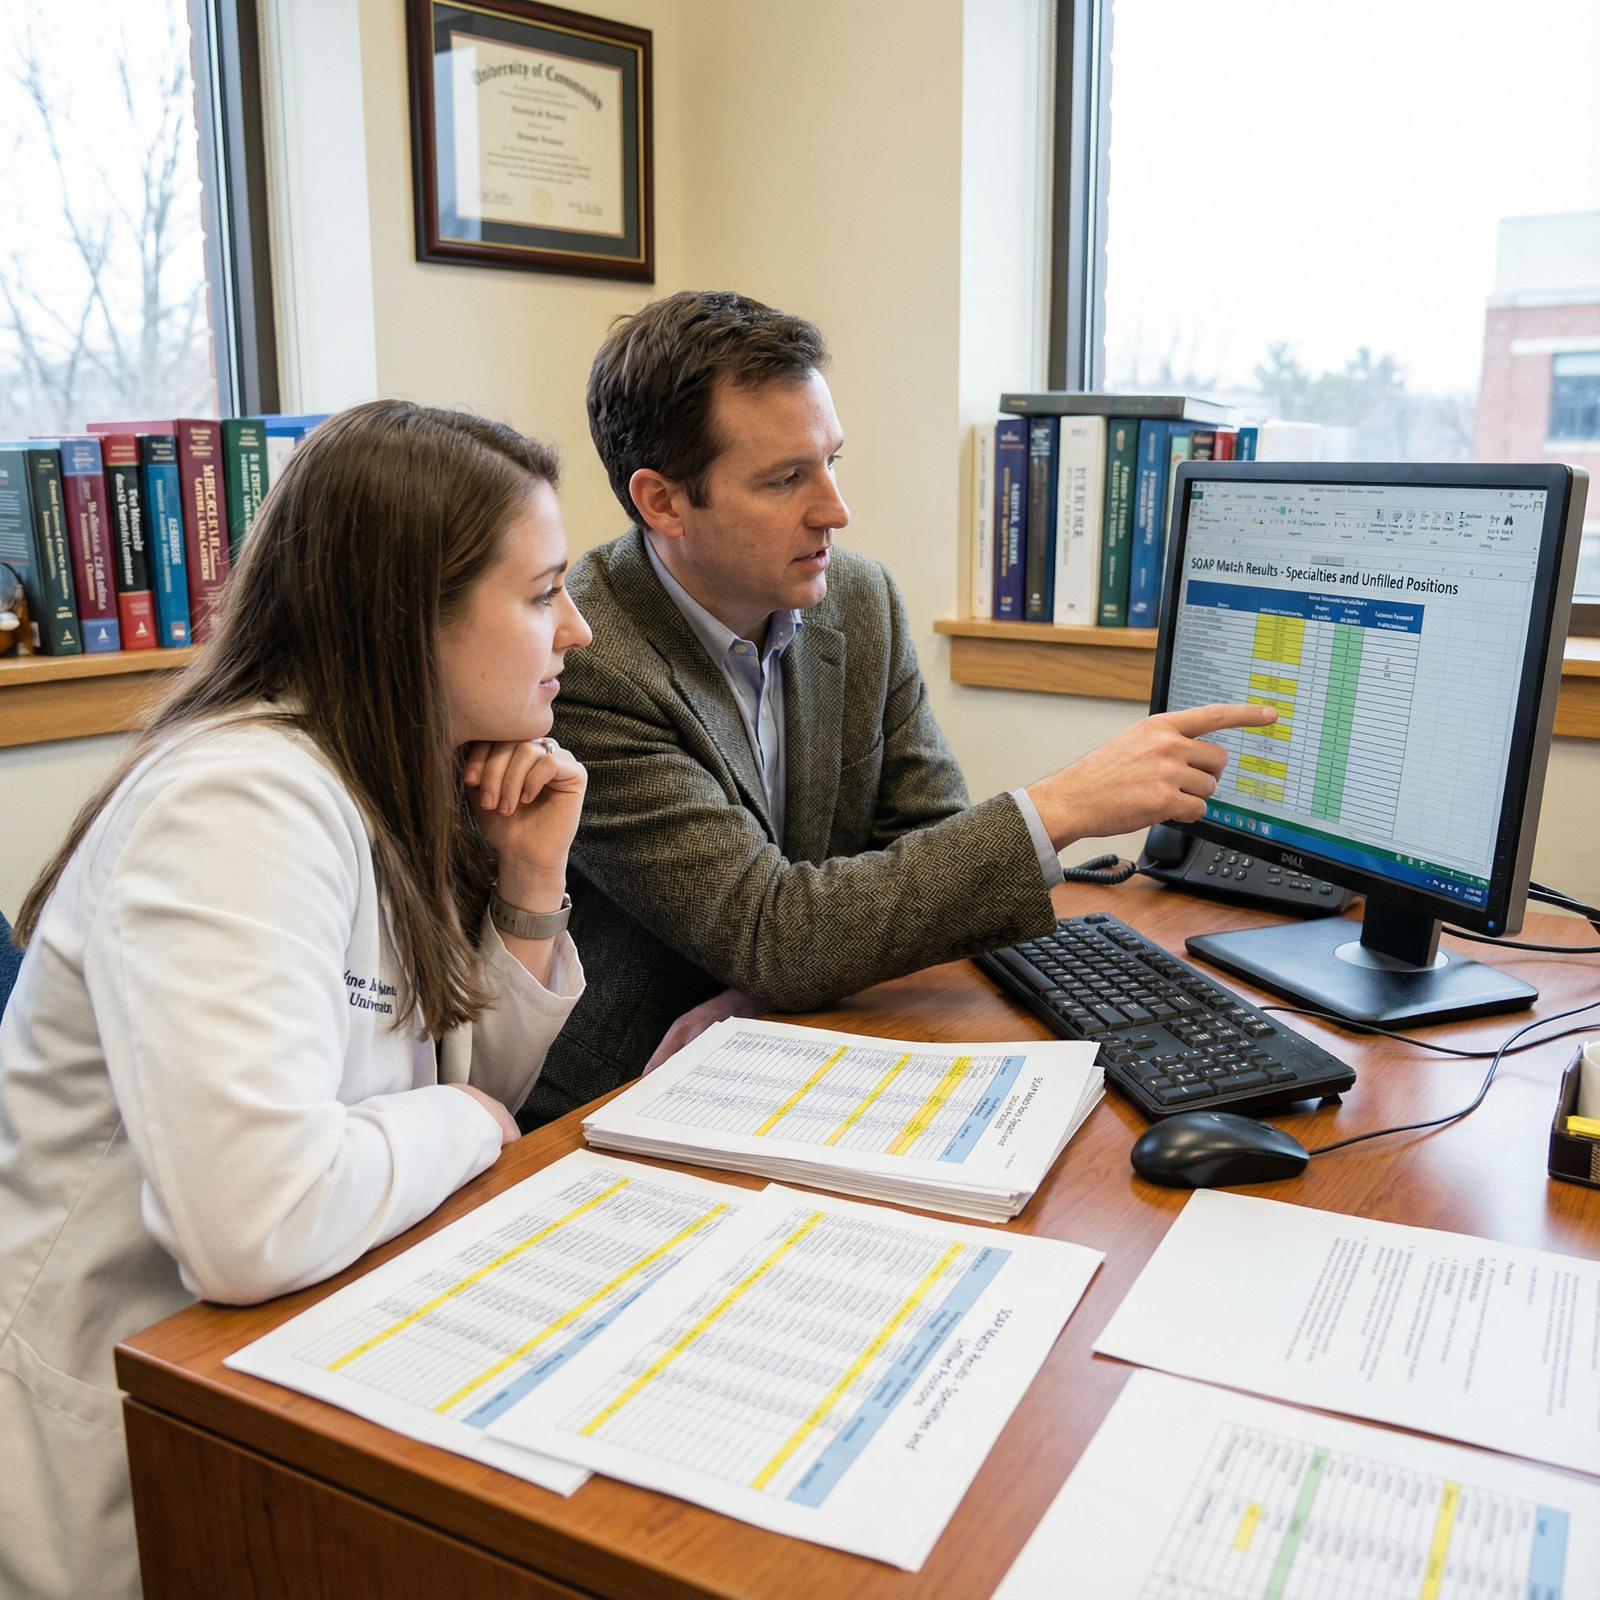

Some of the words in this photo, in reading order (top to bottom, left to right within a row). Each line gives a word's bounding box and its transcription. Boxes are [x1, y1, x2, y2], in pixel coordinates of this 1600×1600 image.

[532, 63, 544, 78] of
[1191, 557, 1215, 571] SOAP
[1216, 559, 1244, 574] Match
[1246, 562, 1279, 577] Results
[1286, 566, 1337, 583] Specialties
[1340, 572, 1359, 585] and
[1362, 573, 1405, 590] Unfilled
[1406, 577, 1459, 595] Positions
